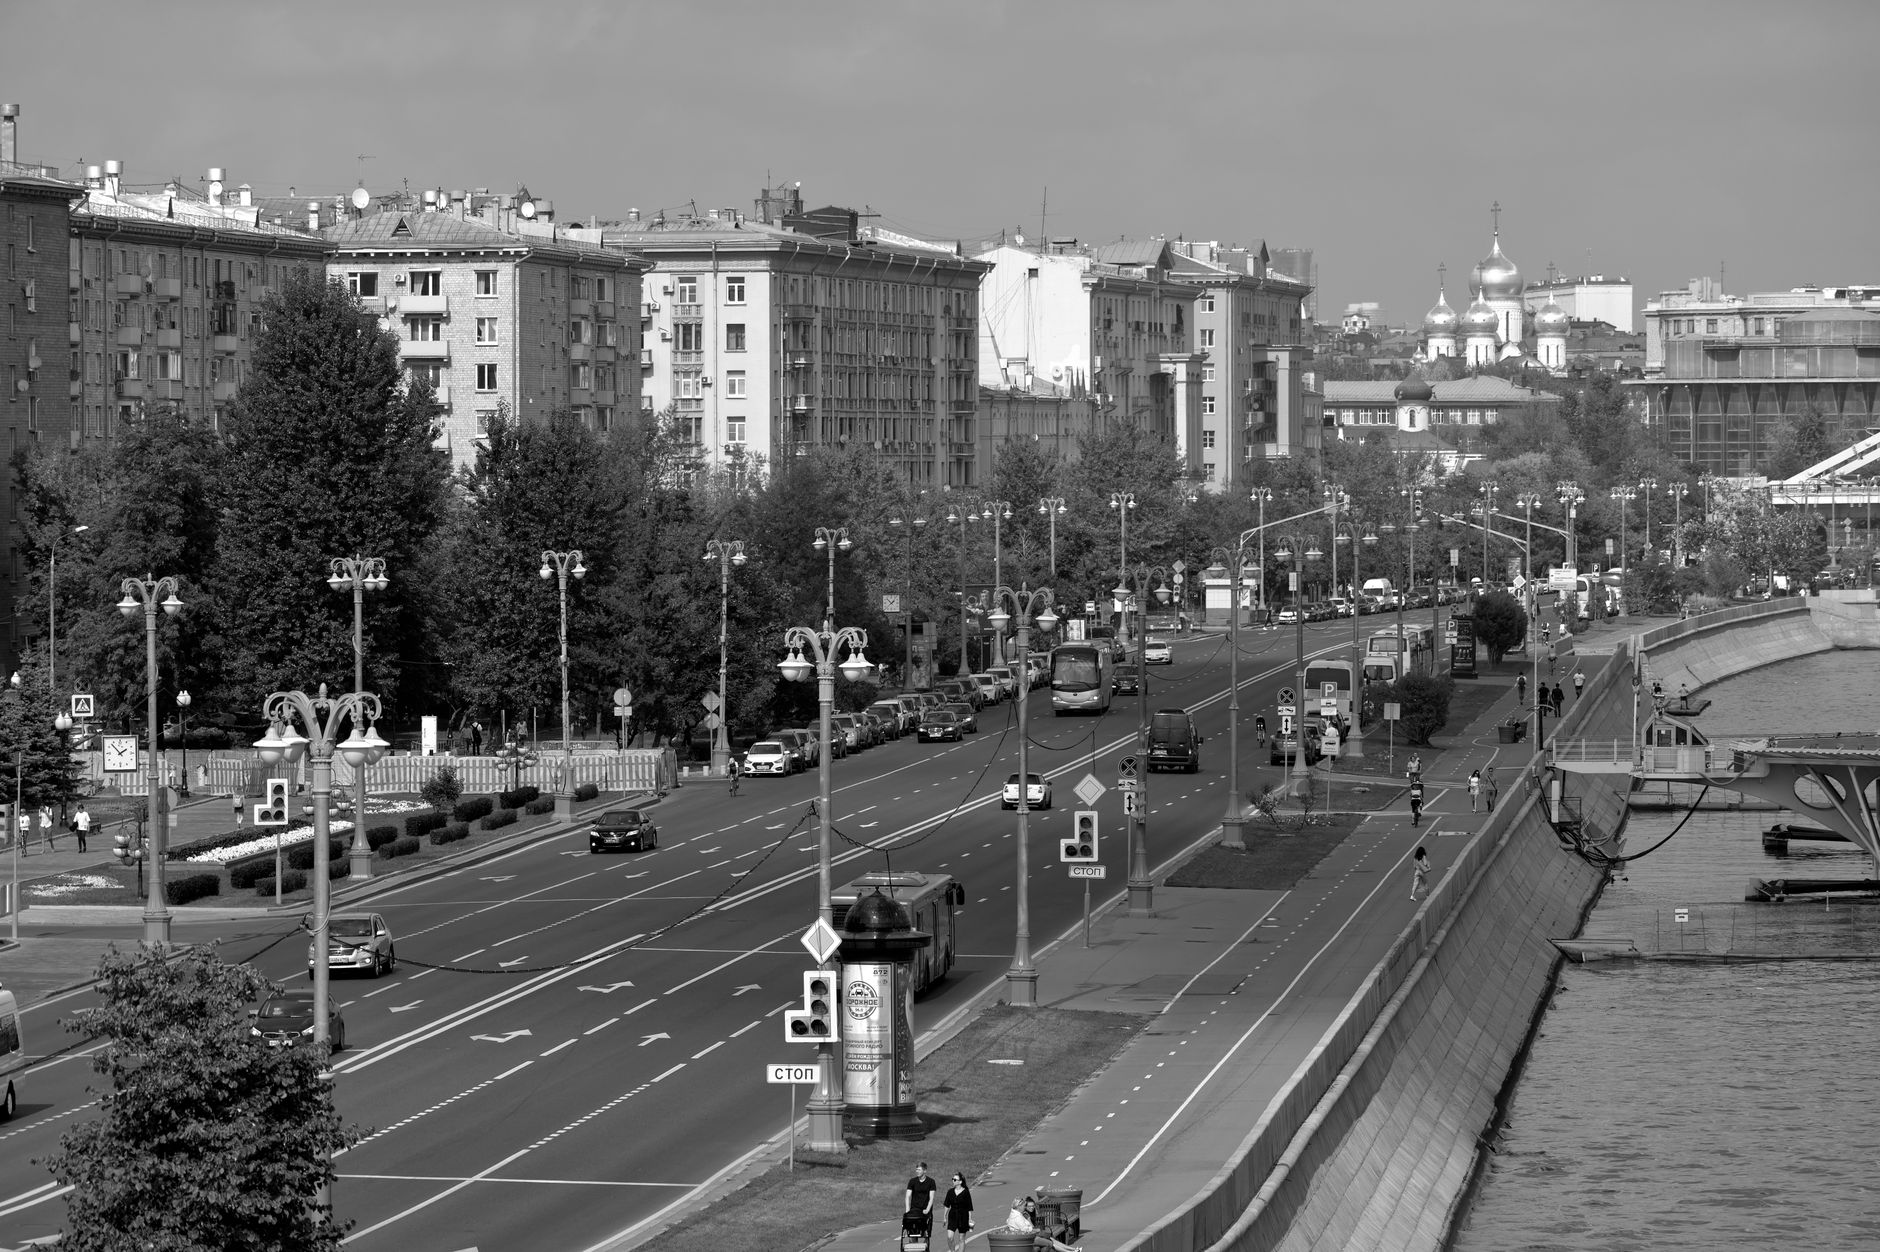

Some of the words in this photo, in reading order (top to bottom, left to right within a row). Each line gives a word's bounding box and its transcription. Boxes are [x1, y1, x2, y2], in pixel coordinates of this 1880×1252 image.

[1448, 621, 1456, 631] P
[1325, 684, 1334, 697] P
[1073, 867, 1101, 876] СТОП
[775, 1067, 814, 1080] СТОП
